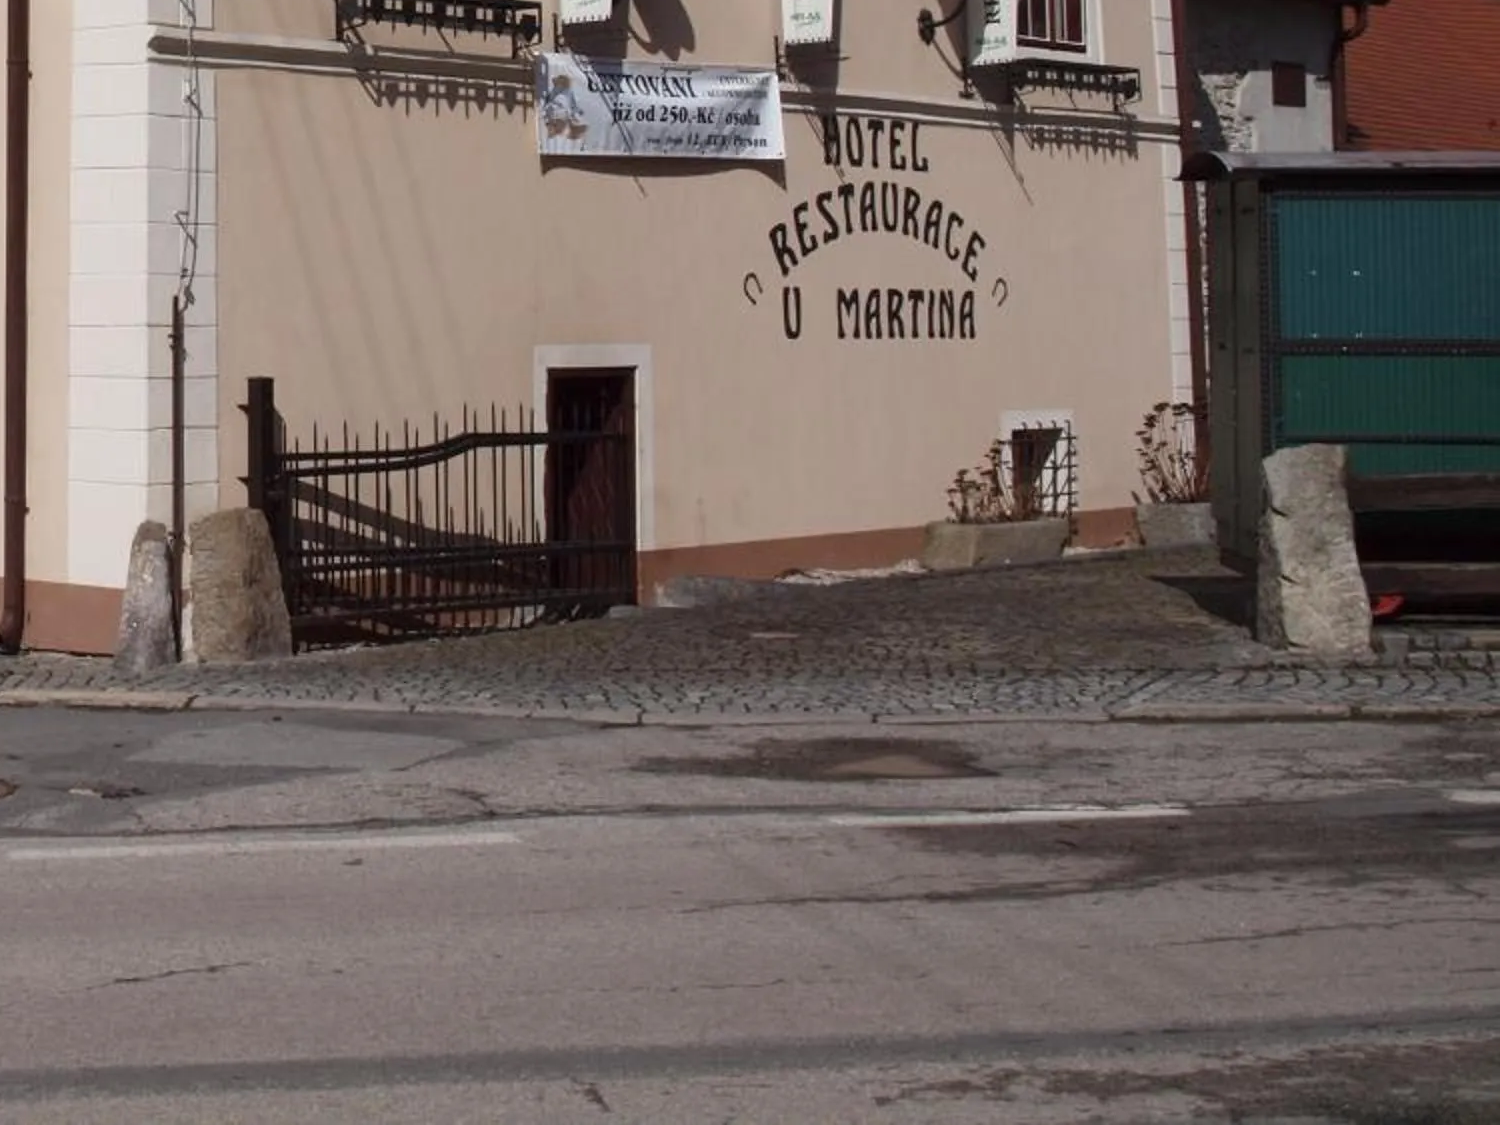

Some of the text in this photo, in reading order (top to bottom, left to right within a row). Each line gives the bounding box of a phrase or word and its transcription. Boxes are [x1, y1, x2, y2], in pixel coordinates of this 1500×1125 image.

[612, 102, 632, 125] již
[636, 105, 655, 123] od
[823, 114, 929, 173] HOTEL
[768, 181, 986, 283] RESTAURACE
[781, 286, 977, 340] U MARTINA
